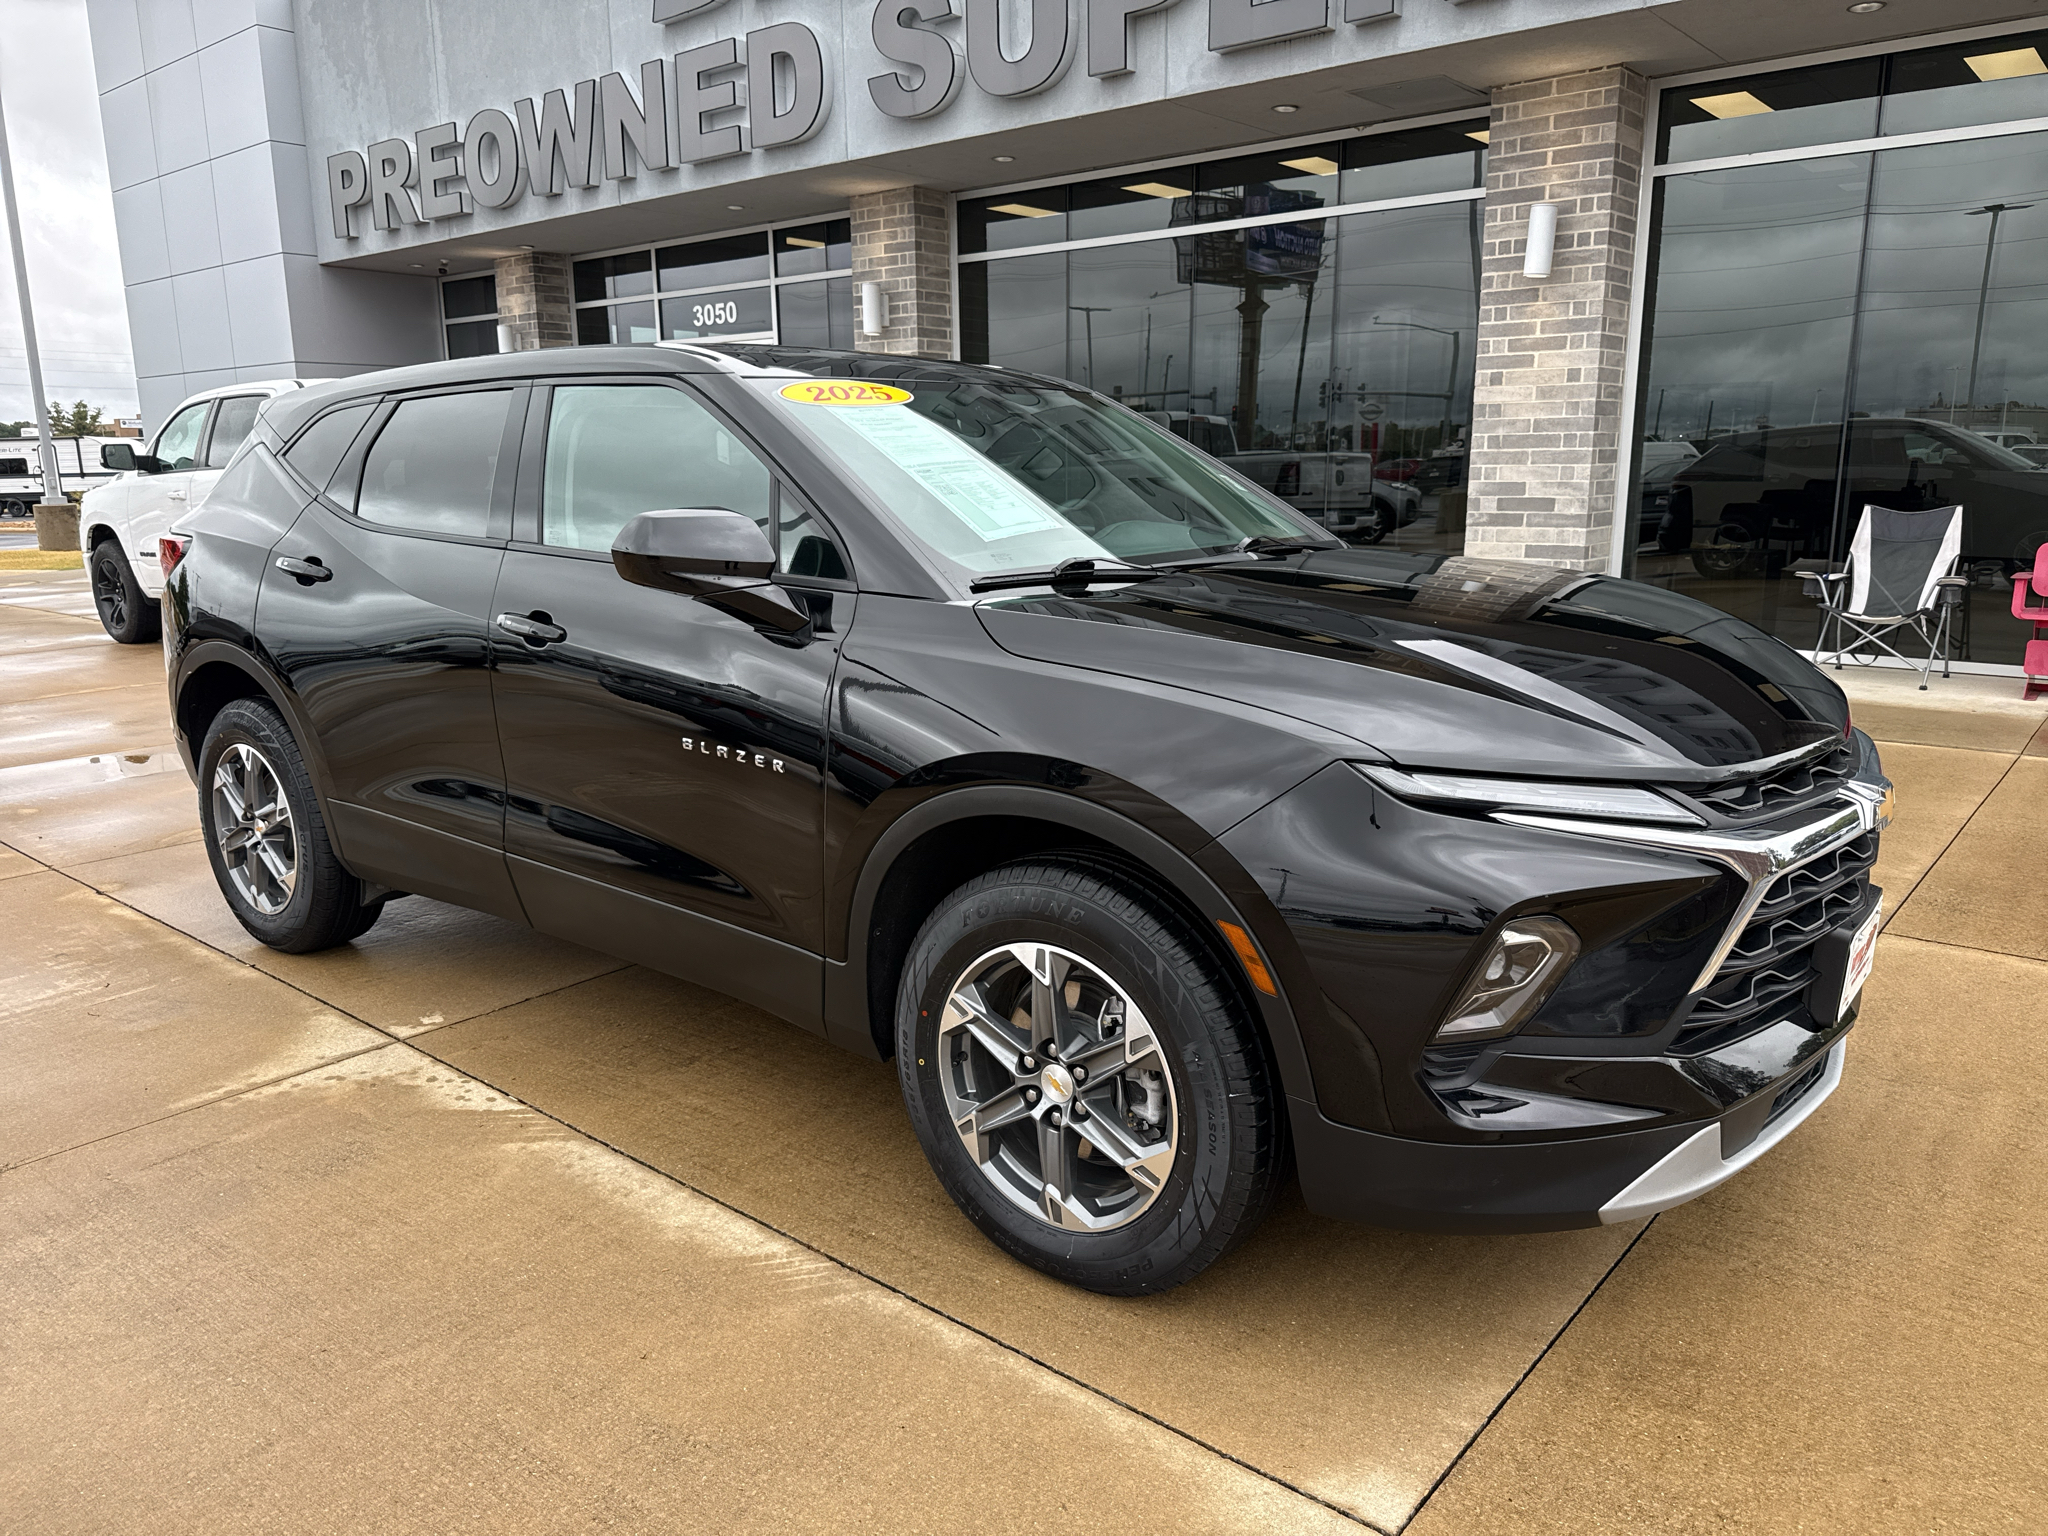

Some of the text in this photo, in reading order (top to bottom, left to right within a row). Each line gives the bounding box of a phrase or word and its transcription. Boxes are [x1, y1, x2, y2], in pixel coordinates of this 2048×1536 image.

[327, 22, 830, 239] PREOWNED
[692, 301, 737, 327] 3050
[805, 385, 892, 402] 2025
[682, 737, 786, 773] BLAZER
[961, 895, 1086, 928] FORTUNE
[1203, 1087, 1217, 1156] SEASON
